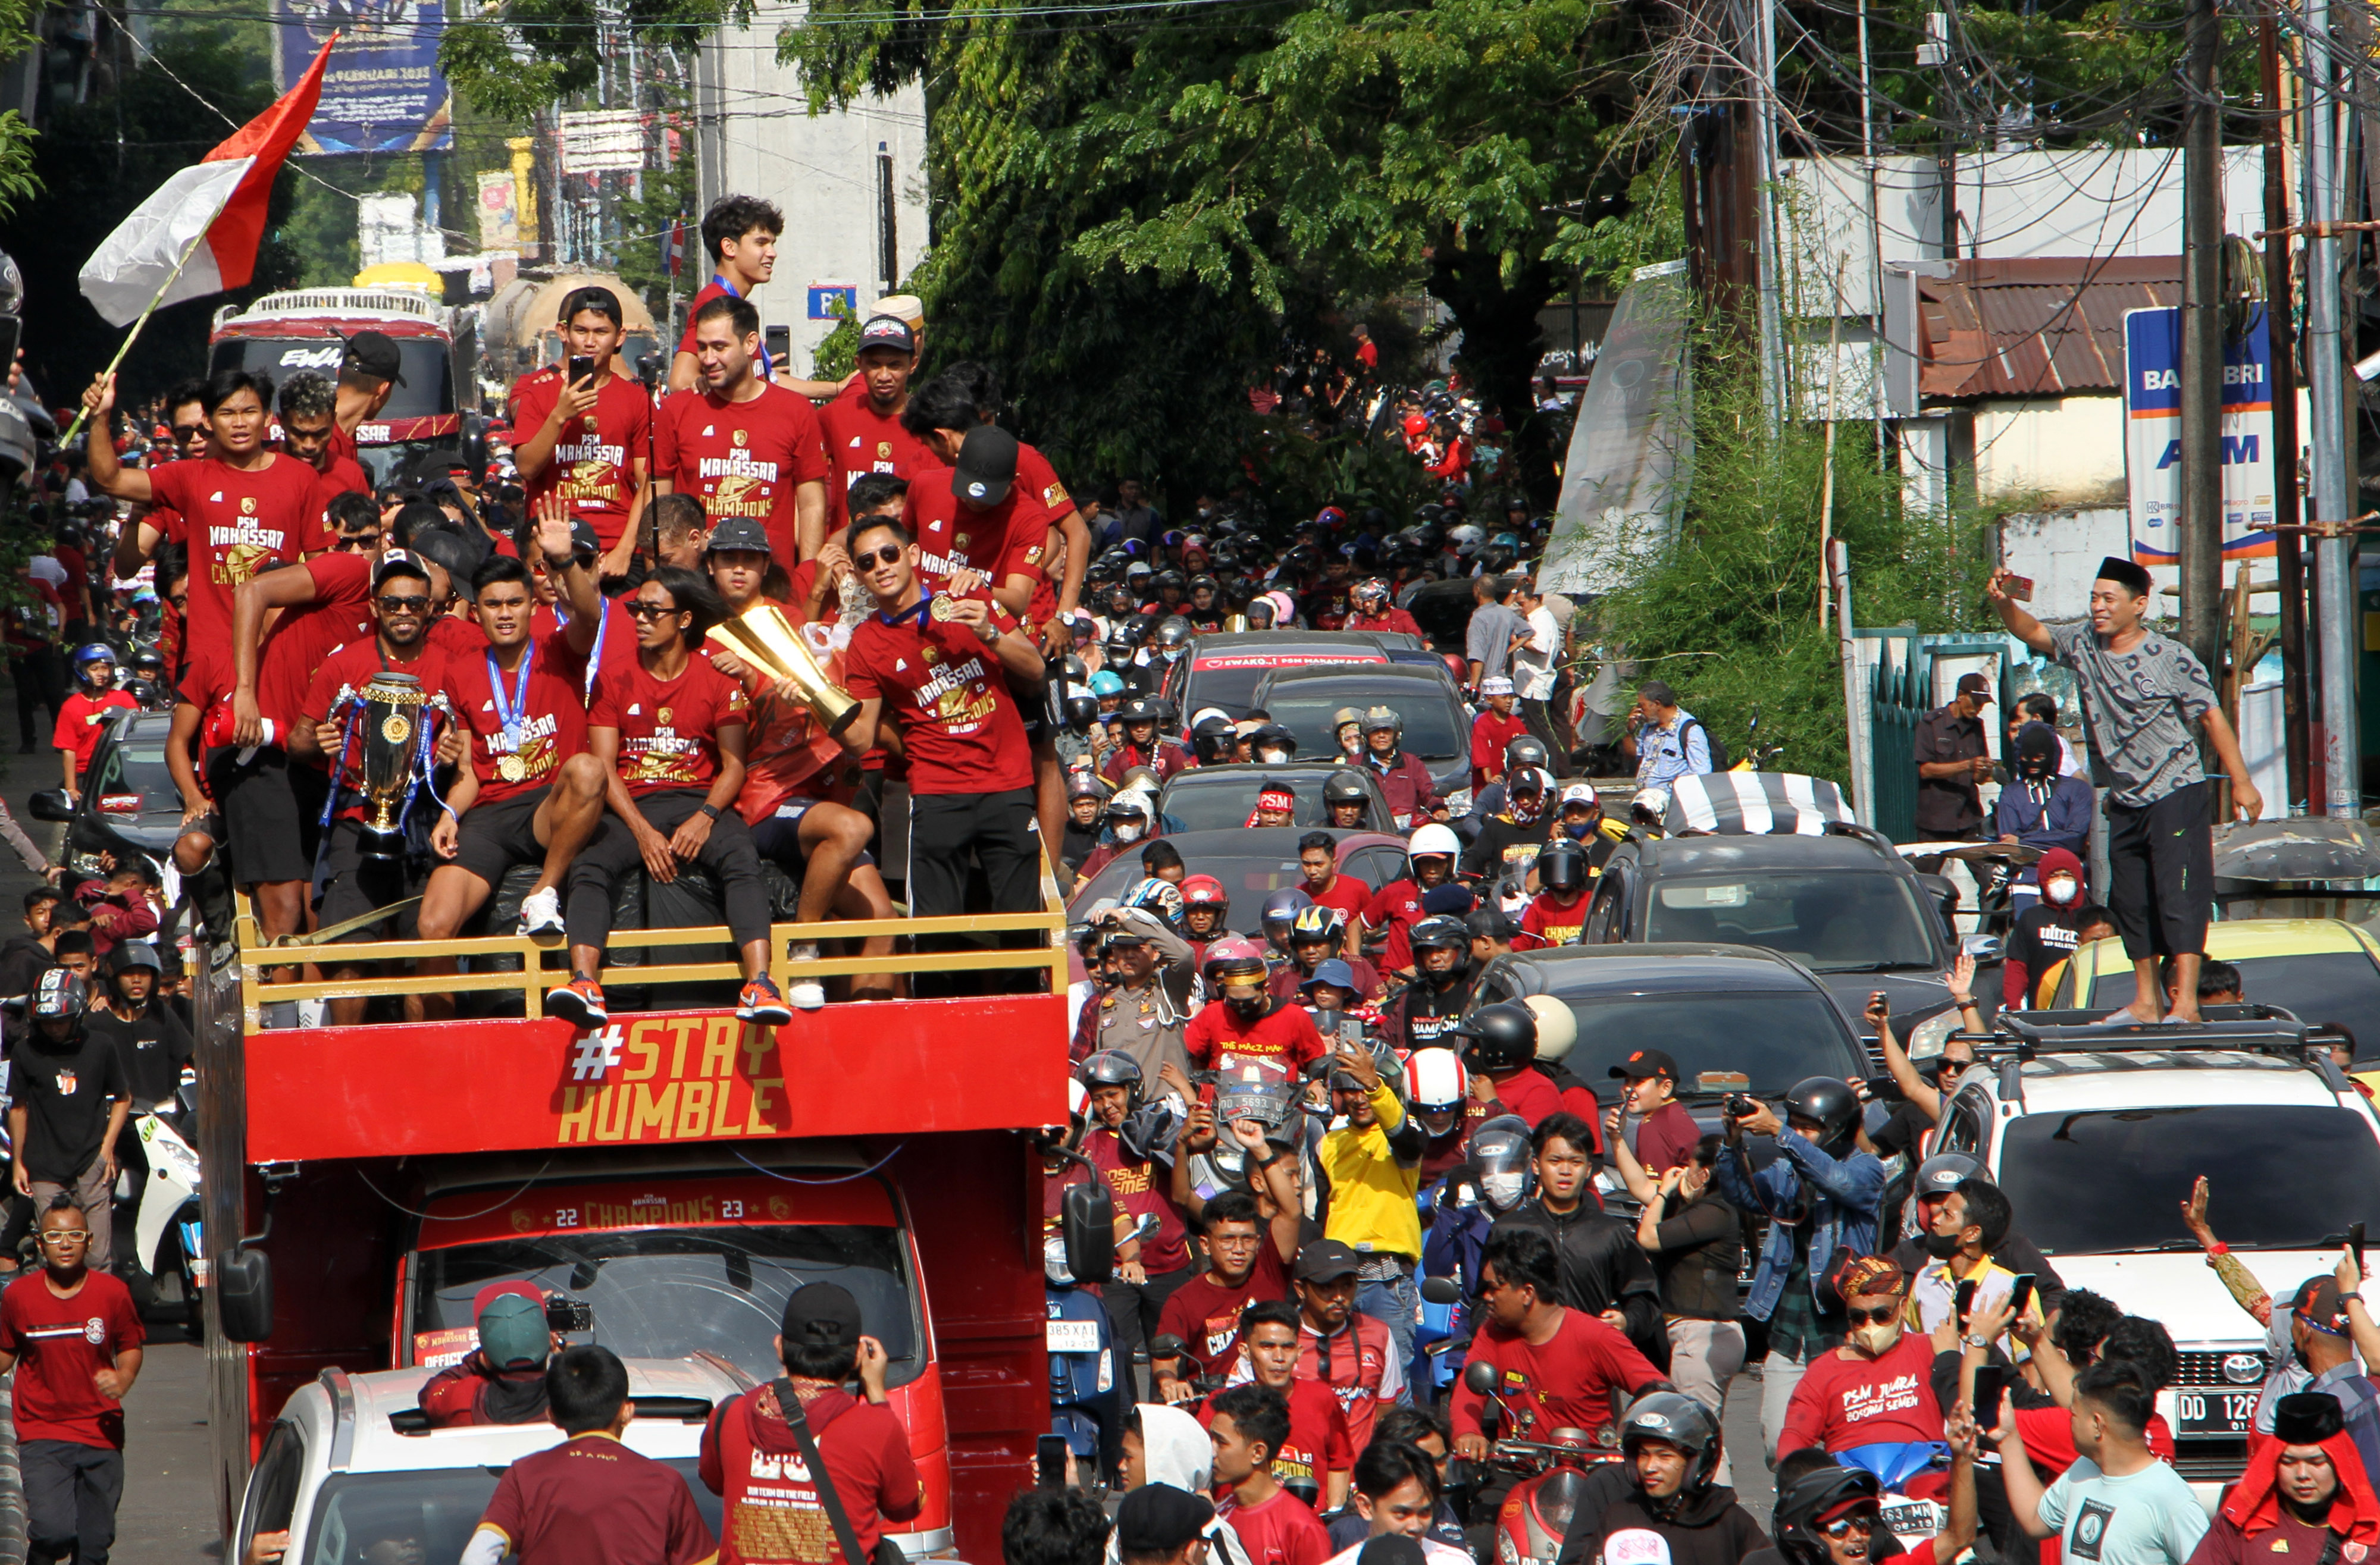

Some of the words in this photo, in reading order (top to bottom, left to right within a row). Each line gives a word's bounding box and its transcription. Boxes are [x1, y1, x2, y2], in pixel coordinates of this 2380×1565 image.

[2144, 369, 2182, 390] BA
[2224, 363, 2263, 385] BRI
[582, 434, 600, 446] PSM
[729, 448, 750, 461] PSM
[2156, 434, 2259, 469] AM
[699, 457, 778, 482] MAKASSAR
[873, 460, 894, 473] PSM
[704, 484, 713, 493] 22
[237, 516, 258, 529] PSM
[209, 525, 284, 551] MAKASSAR
[948, 549, 969, 565] PSM
[929, 661, 951, 680] PSM
[654, 726, 675, 738] PSM
[1259, 794, 1288, 810] PSM
[572, 1017, 778, 1081] #STAY
[1220, 1041, 1236, 1050] THE
[1265, 1045, 1283, 1053] MAN
[558, 1077, 784, 1143] HUMBLE
[1275, 1102, 1282, 1112] U
[632, 1197, 666, 1207] MAKASSAR
[556, 1208, 577, 1227] 22
[584, 1194, 714, 1230] CHAMPIONS
[722, 1200, 743, 1218] 23
[431, 1334, 467, 1347] MAKASSAR
[1842, 1384, 1872, 1407] PSM
[1878, 1372, 1919, 1398] JUARA
[1886, 1394, 1919, 1412] SEMEN
[2180, 1395, 2206, 1420] DD
[1302, 1453, 1313, 1463] 23
[798, 1490, 818, 1501] FIELD
[1912, 1504, 1931, 1518] MN
